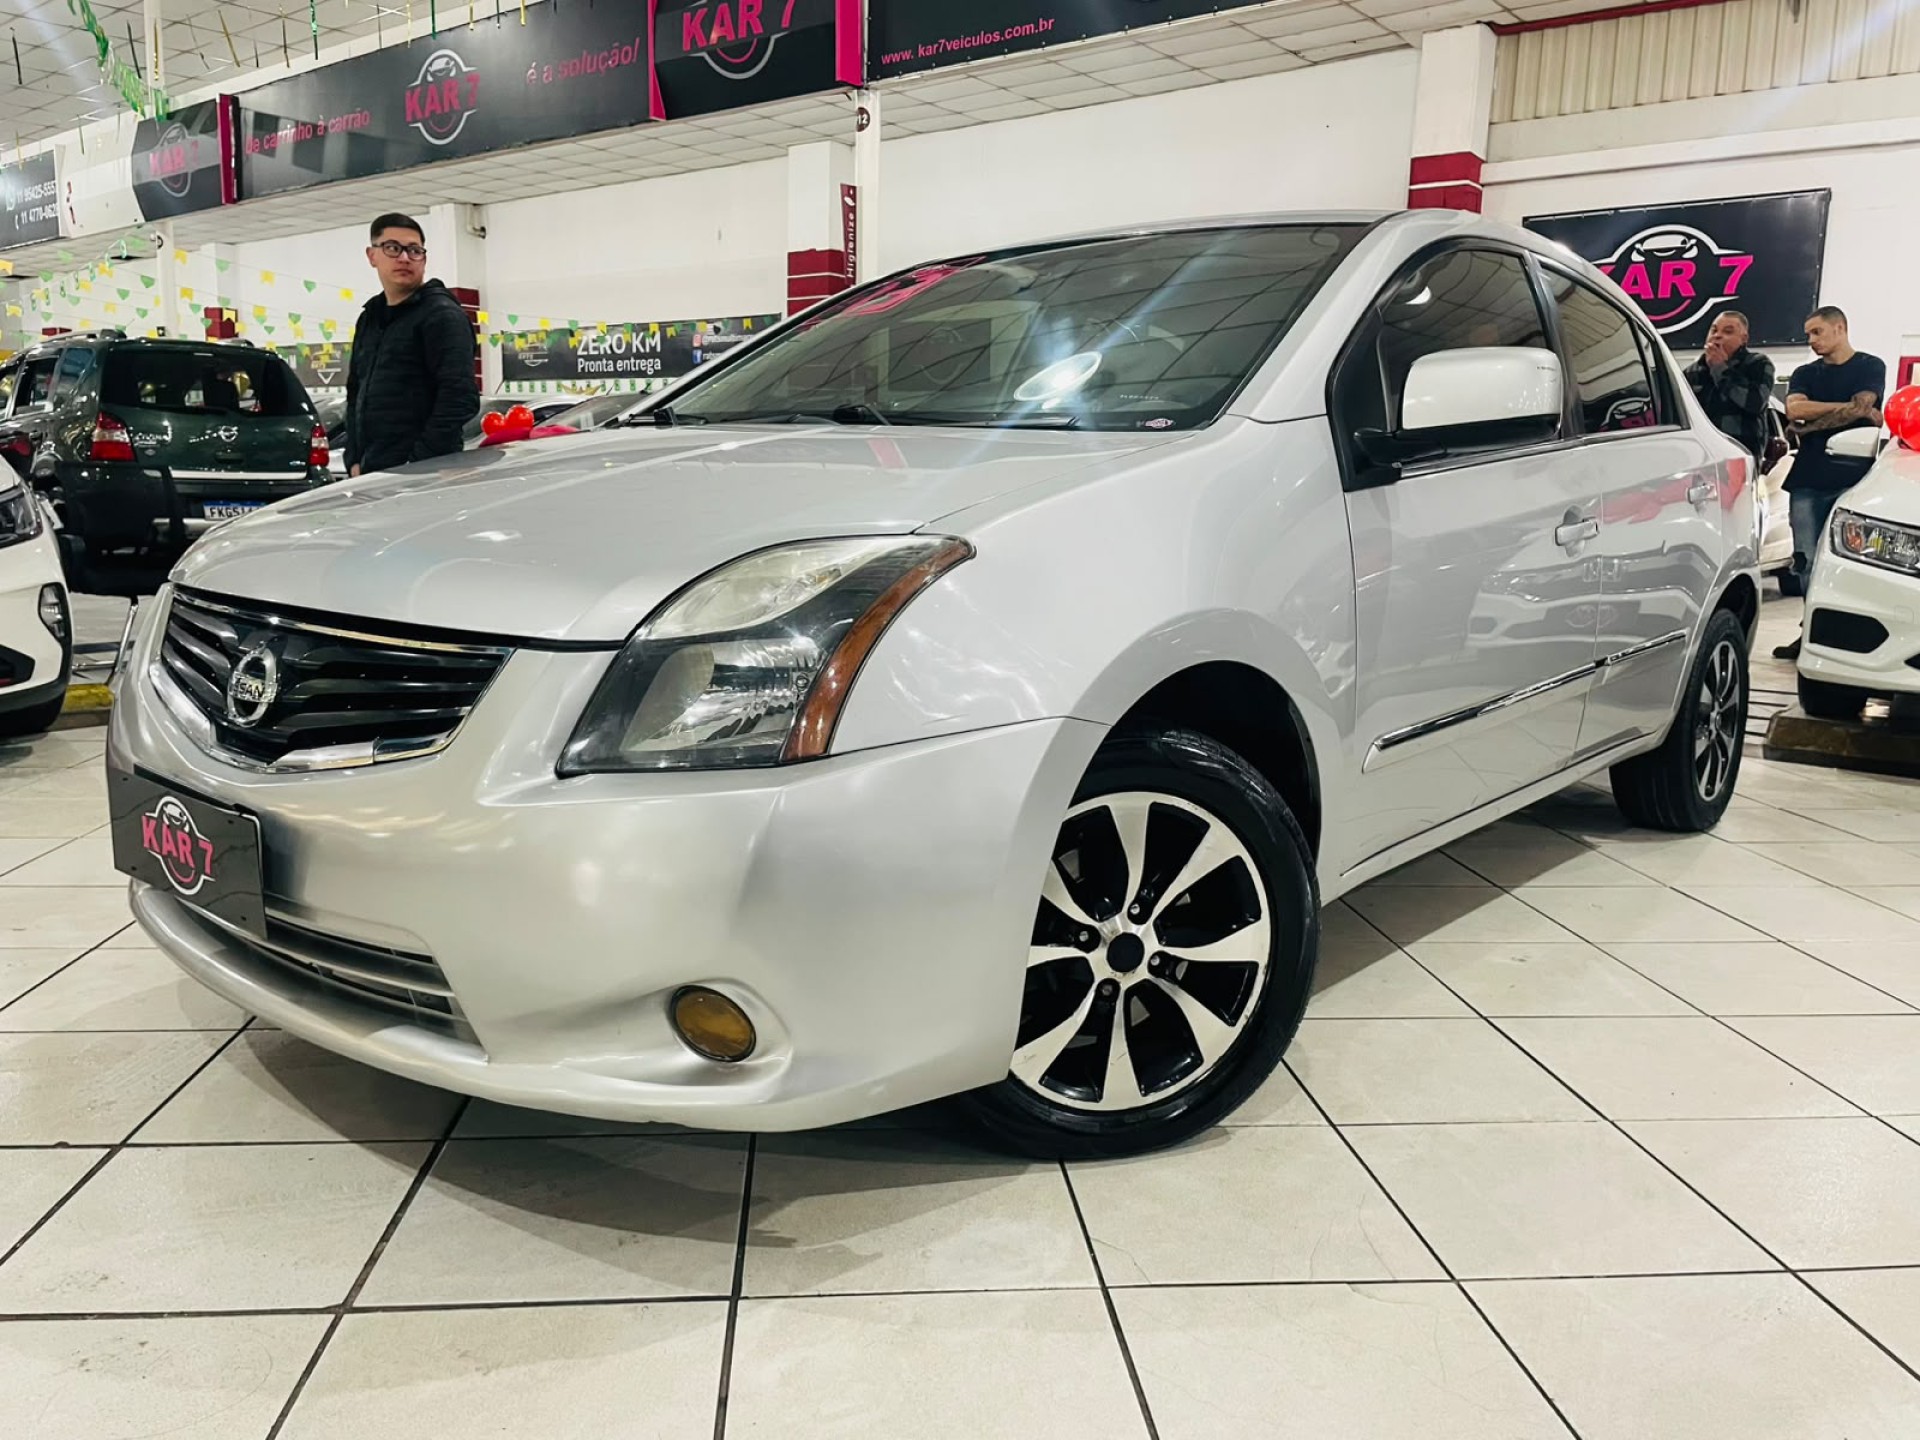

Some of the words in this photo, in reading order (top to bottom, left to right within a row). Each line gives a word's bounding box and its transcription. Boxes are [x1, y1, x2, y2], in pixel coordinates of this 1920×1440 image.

[682, 0, 764, 51] KAR
[881, 49, 914, 65] www.
[918, 17, 1055, 58] kar7veiculos.com.br
[543, 65, 552, 83] a
[559, 36, 640, 80] solução!
[405, 78, 461, 123] KAR
[466, 72, 480, 109] 7
[263, 122, 313, 150] carrinho
[149, 143, 185, 177] KAR
[1598, 259, 1697, 299] AR
[1719, 254, 1754, 296] 7
[577, 333, 626, 356] ZERO
[631, 330, 661, 354] KM
[577, 357, 614, 373] Pronta
[616, 356, 661, 375] entrega
[142, 815, 195, 869] KAR
[198, 839, 213, 876] 7
